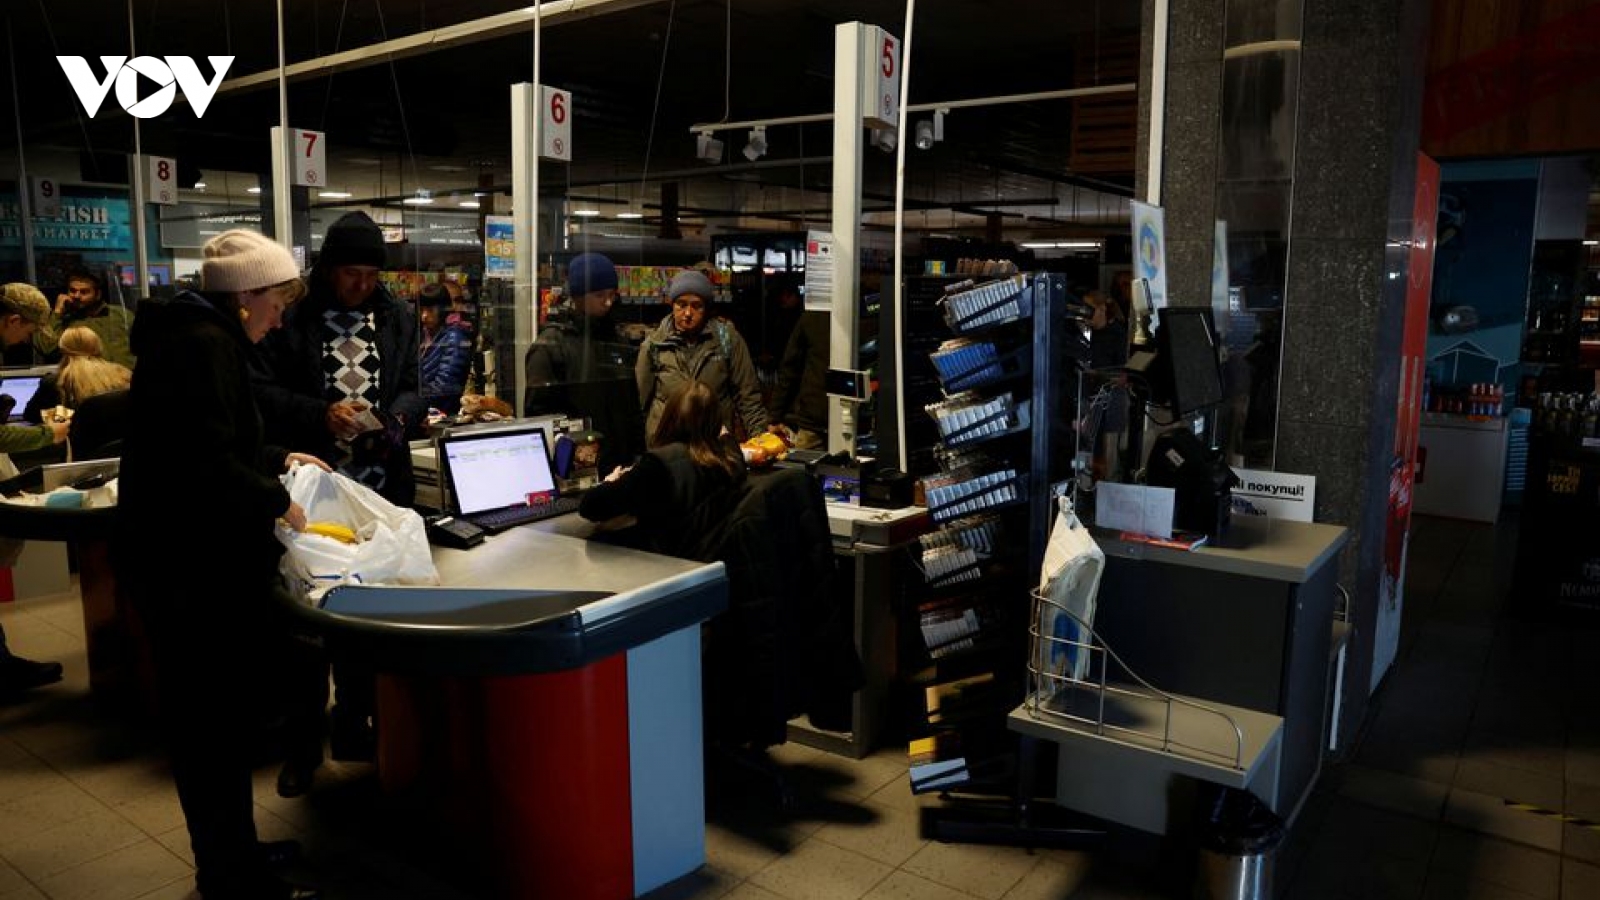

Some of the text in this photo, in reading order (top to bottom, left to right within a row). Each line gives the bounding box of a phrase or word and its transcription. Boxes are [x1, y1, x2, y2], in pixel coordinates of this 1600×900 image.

[882, 39, 894, 77] 5
[551, 92, 565, 124] 6
[302, 133, 317, 158] 7
[158, 161, 169, 181] 8
[41, 180, 54, 198] 9
[1248, 482, 1304, 496] покупці!
